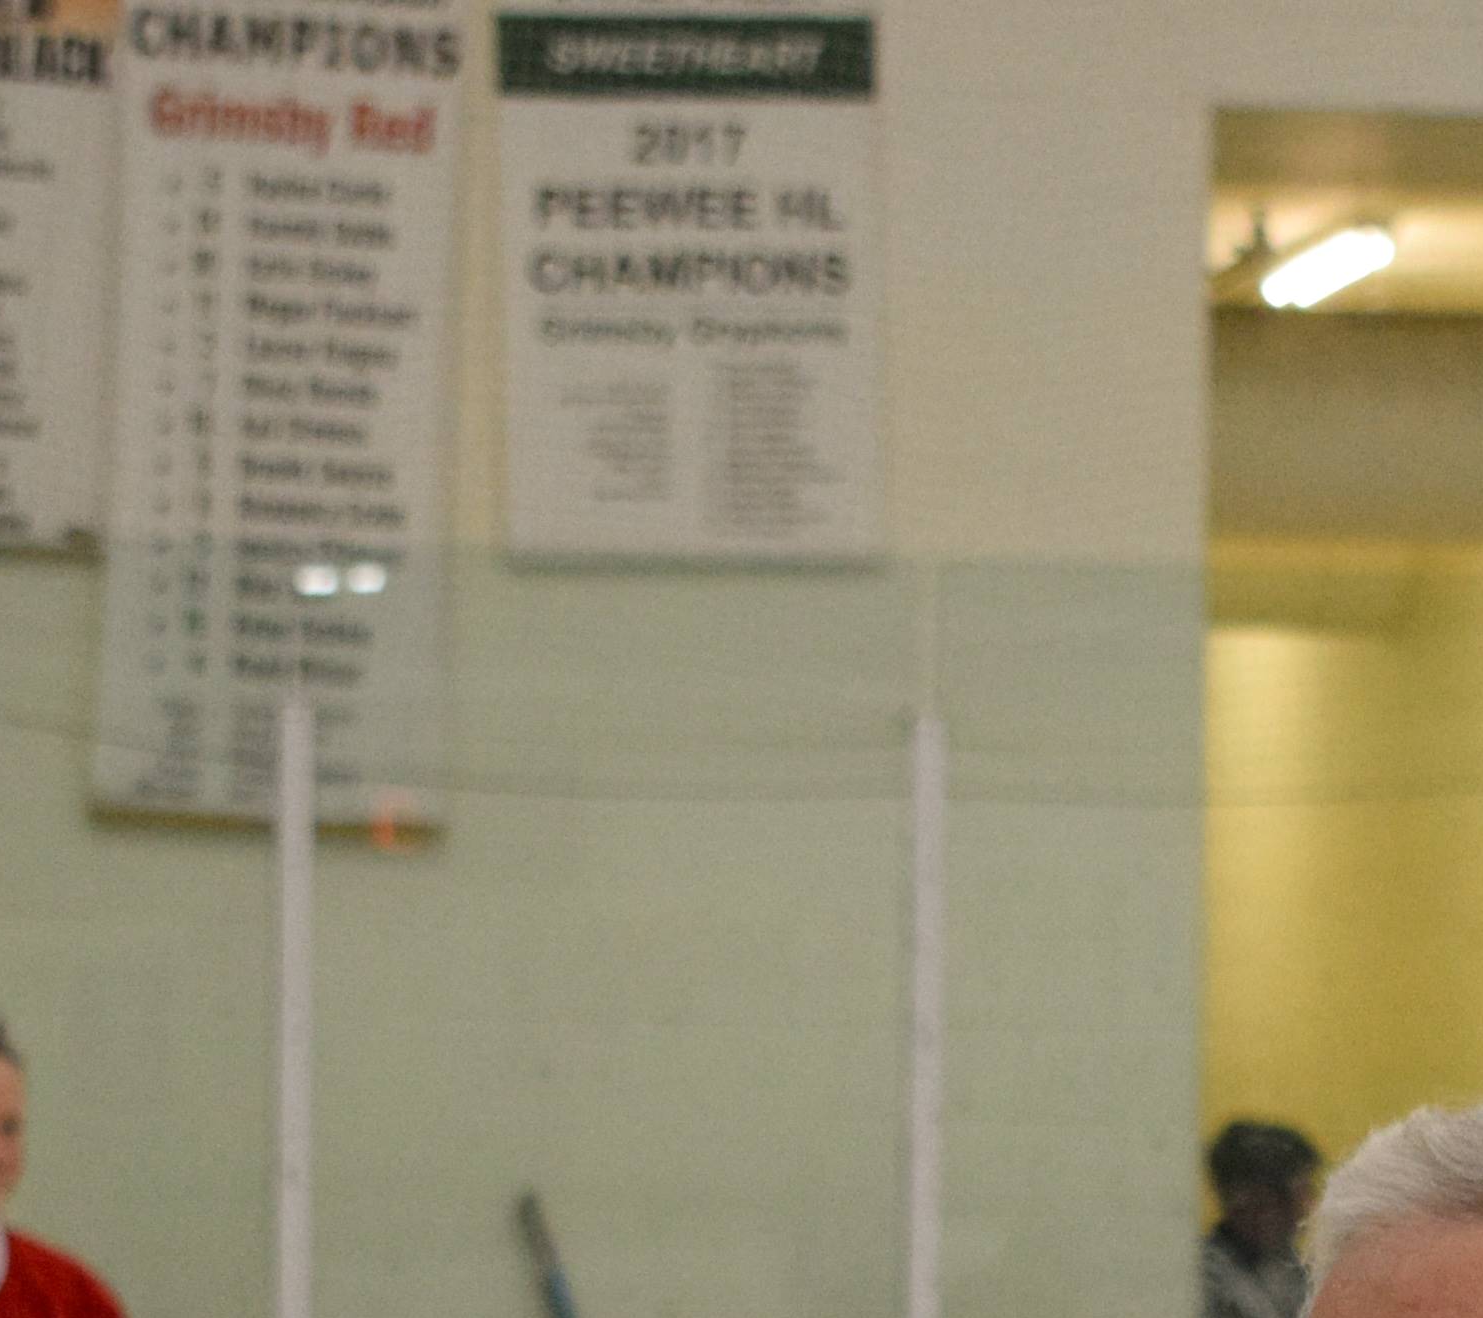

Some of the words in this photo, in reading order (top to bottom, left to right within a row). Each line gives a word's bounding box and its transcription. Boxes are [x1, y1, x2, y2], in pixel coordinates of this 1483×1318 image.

[129, 7, 461, 81] CHAMPIONS
[150, 82, 335, 156] Grimsby
[350, 94, 438, 156] Red
[633, 120, 747, 167] 2017
[536, 184, 760, 232] PEEWEE
[528, 248, 851, 295] CHAMPIONS
